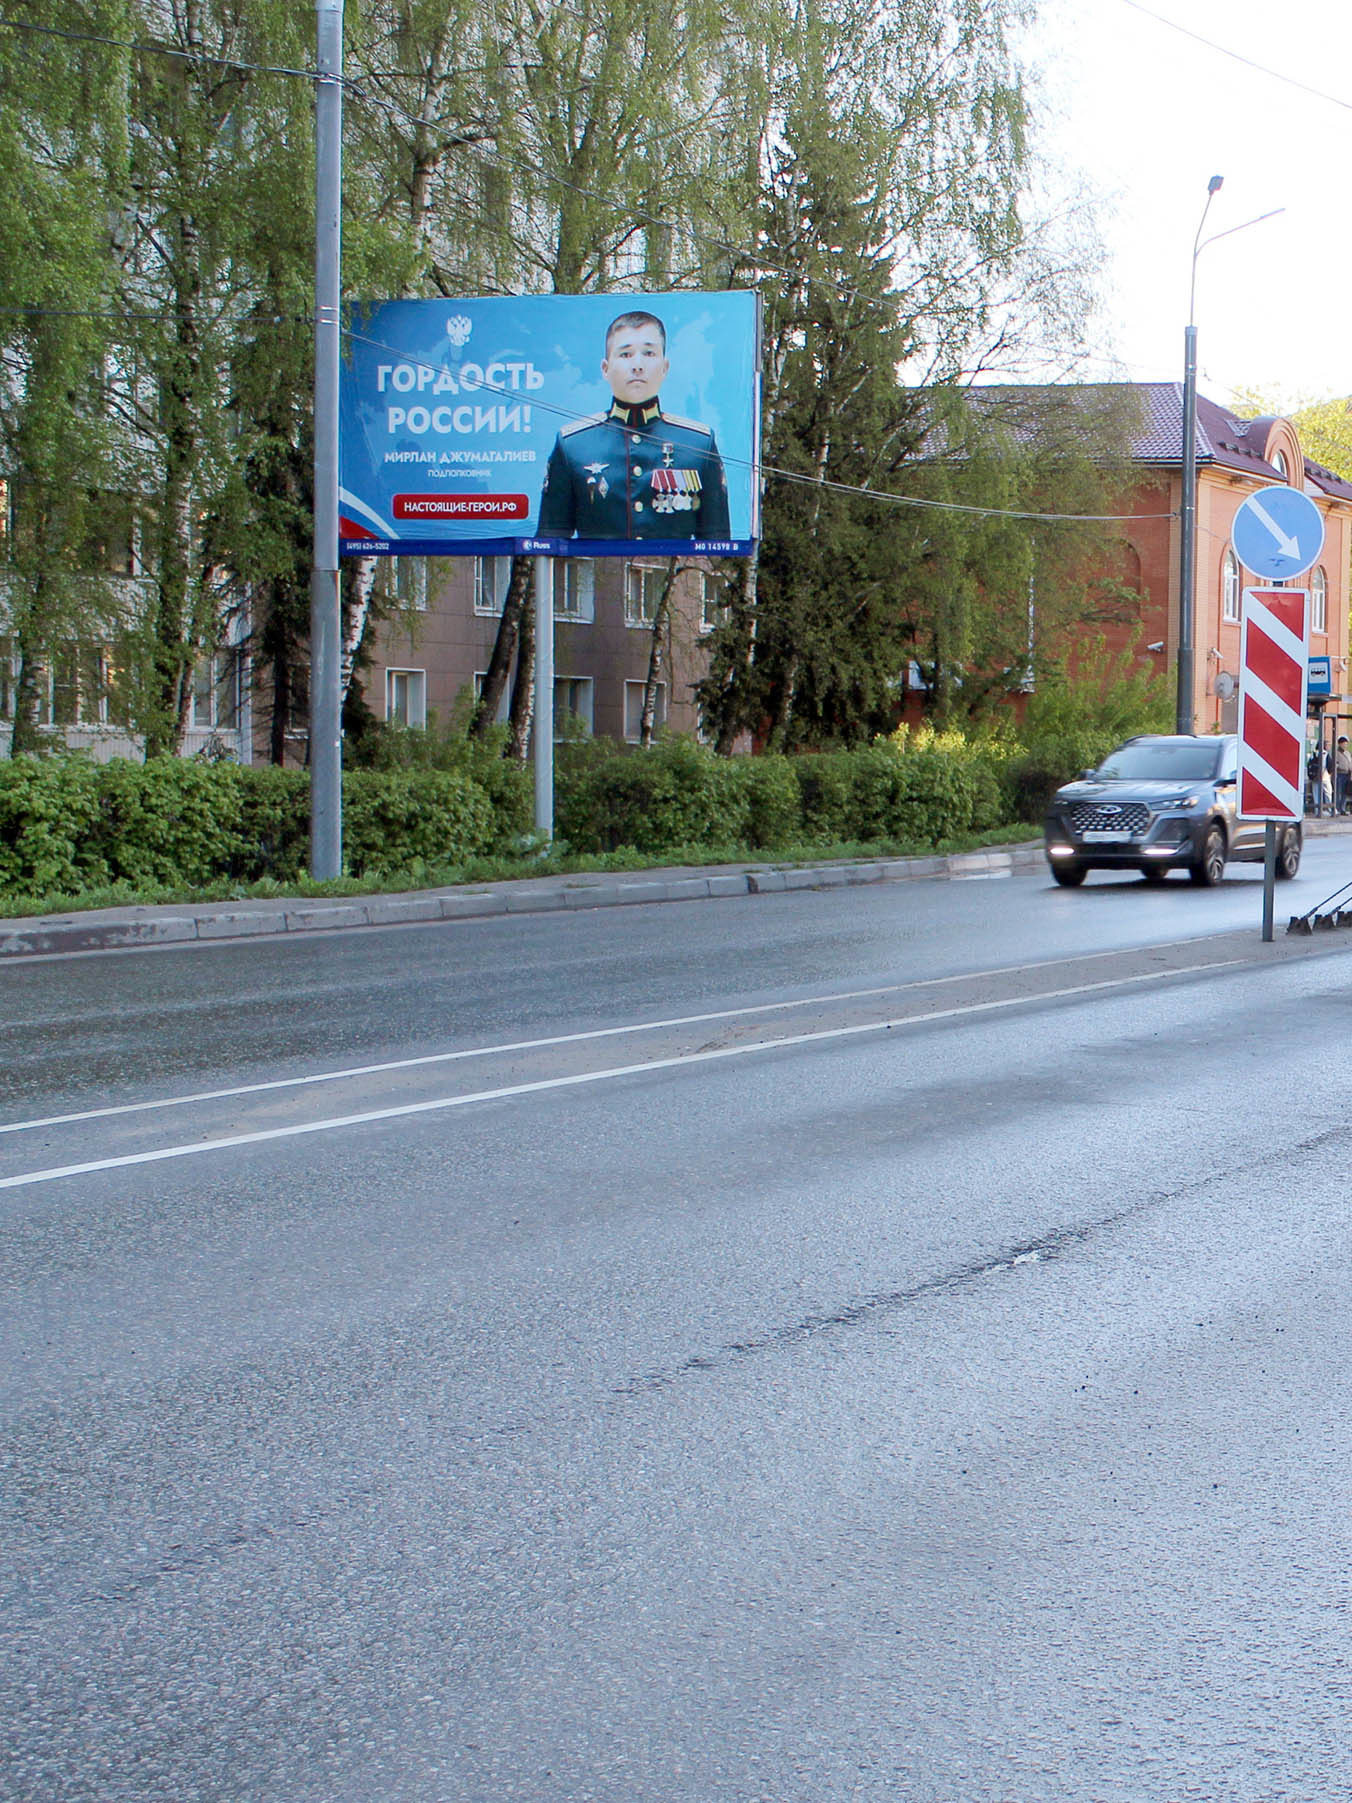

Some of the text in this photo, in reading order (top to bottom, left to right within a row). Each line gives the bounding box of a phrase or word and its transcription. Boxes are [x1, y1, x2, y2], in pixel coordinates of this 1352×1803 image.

[377, 363, 545, 395] ГОРДОСТЬ
[388, 405, 532, 434] РОССИИ!
[384, 450, 536, 464] МИРЛАН ДЖУМАГАЛИЕВ
[404, 501, 517, 513] НАСТОЯЩИЕ-ГЕРОИ.РФ
